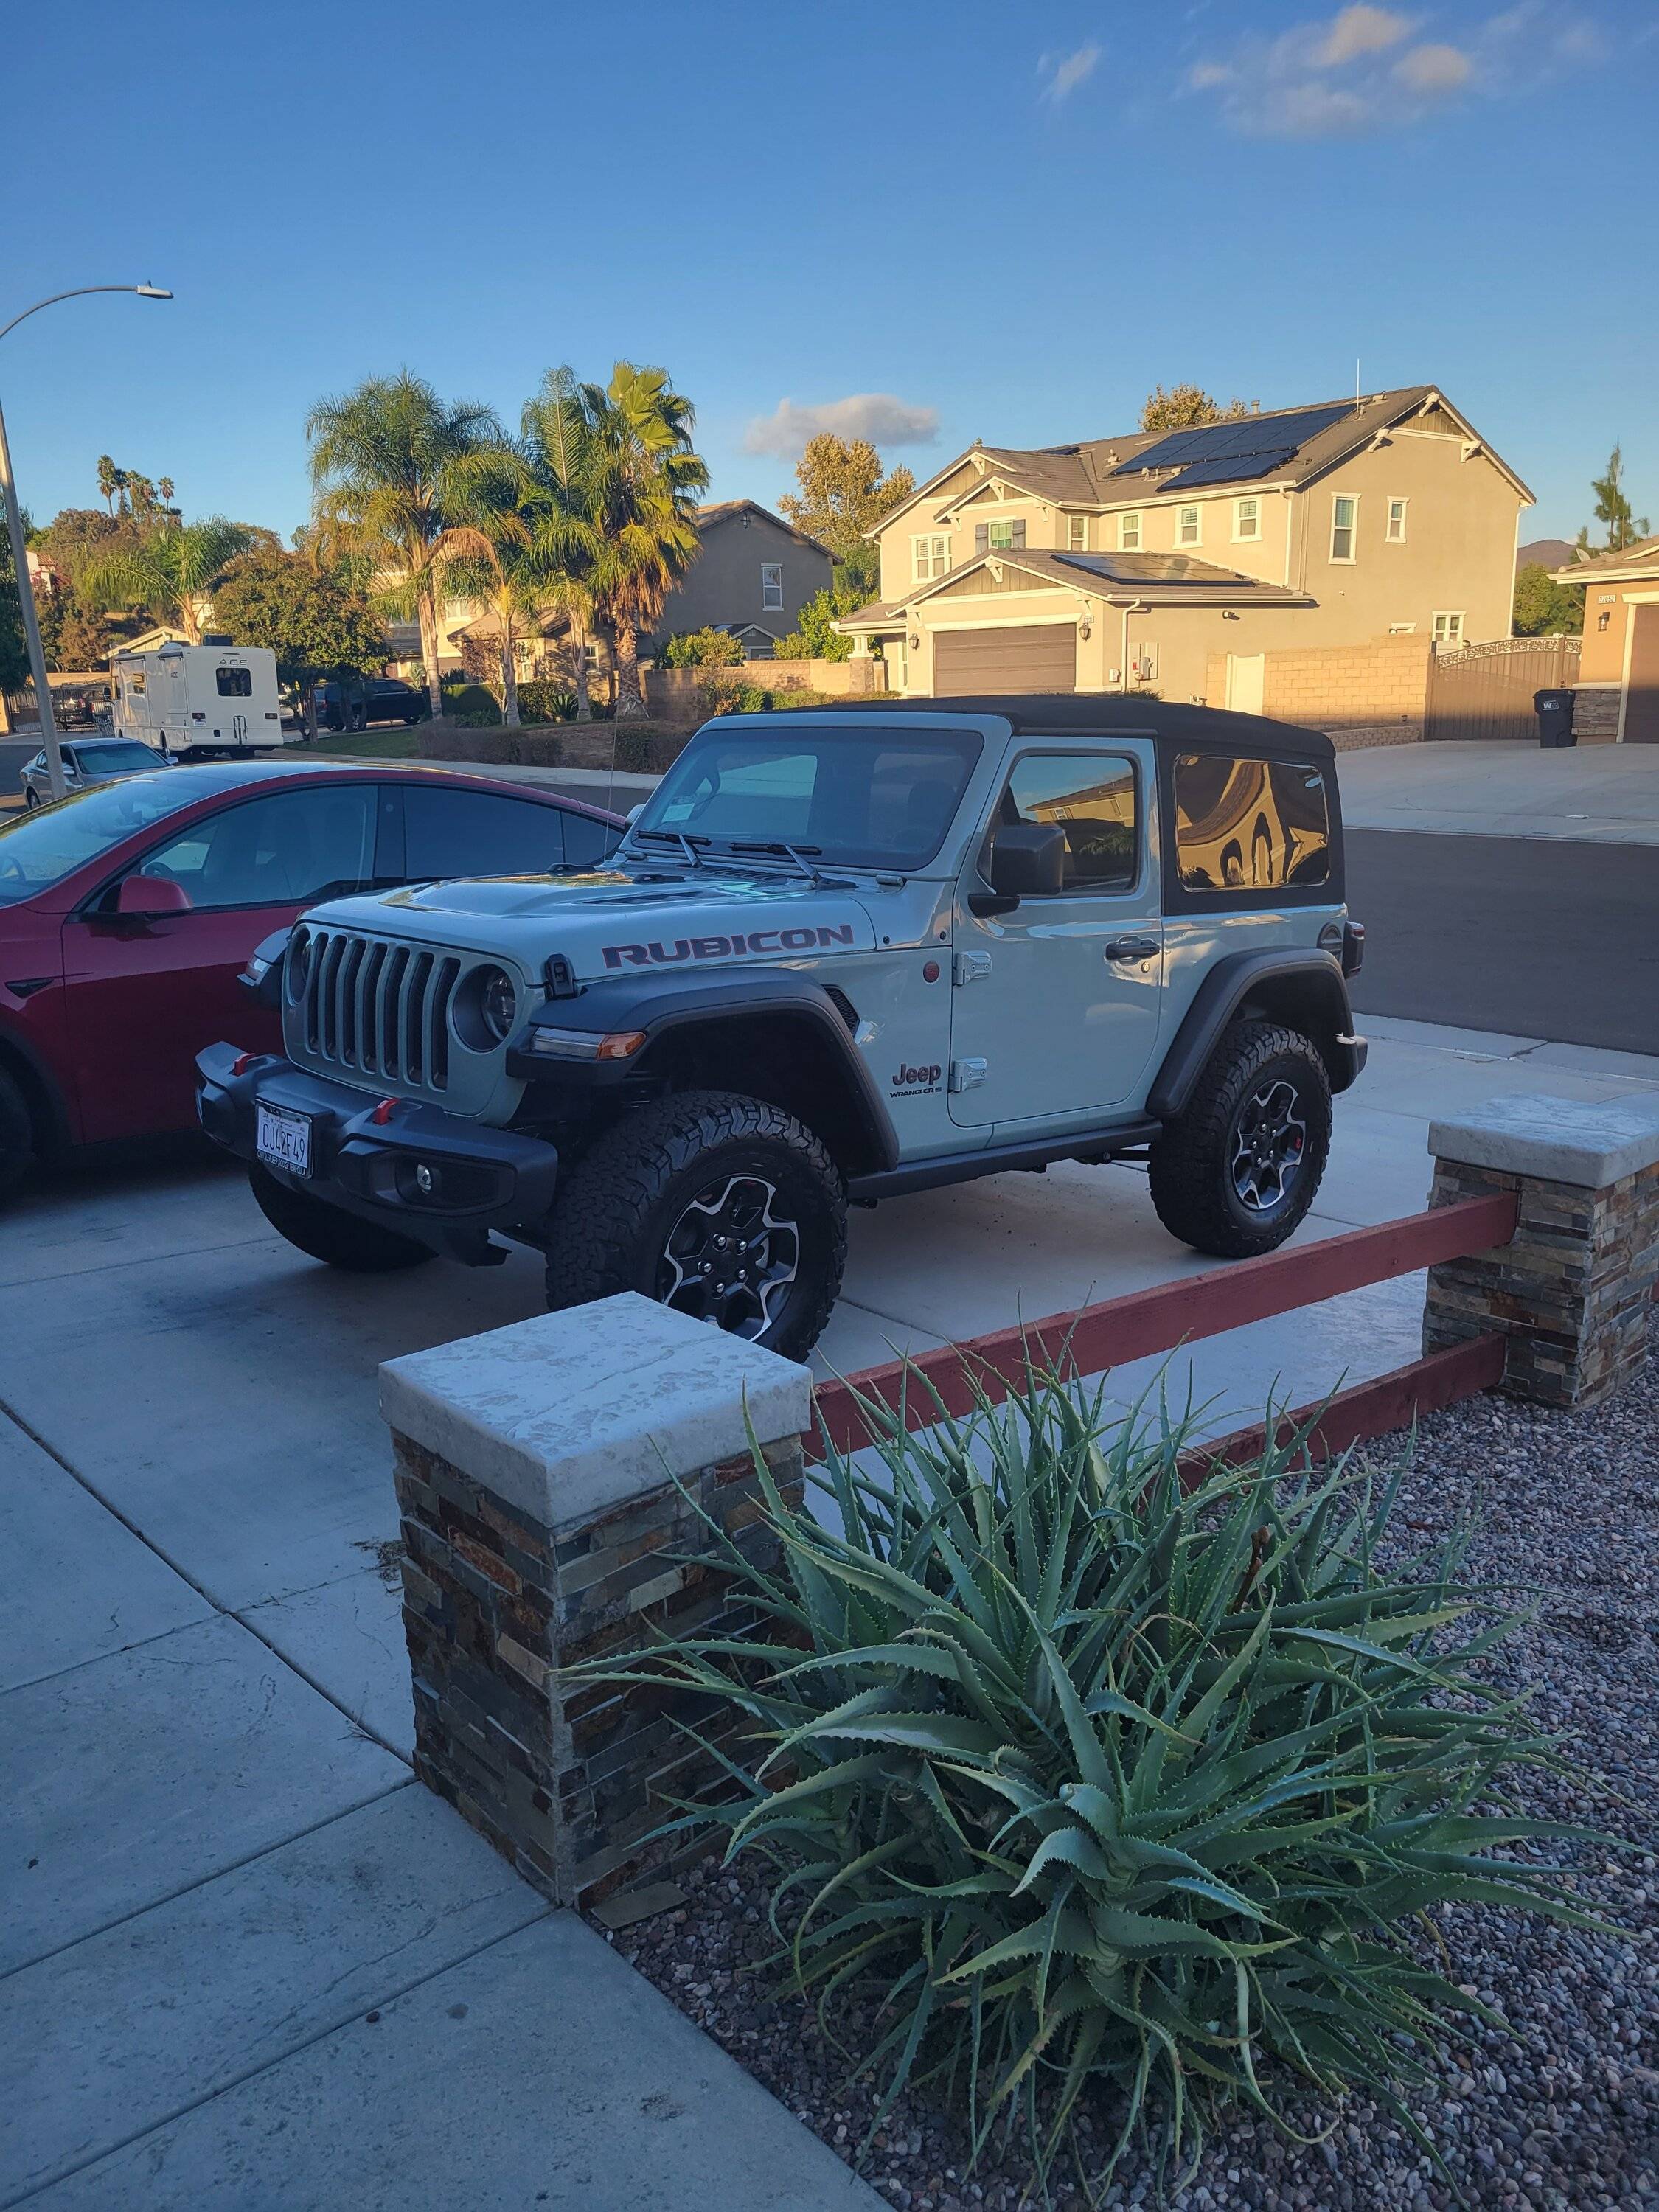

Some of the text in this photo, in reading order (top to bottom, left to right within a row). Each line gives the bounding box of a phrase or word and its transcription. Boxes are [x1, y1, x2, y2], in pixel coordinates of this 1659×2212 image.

[601, 924, 855, 969] RUBICON
[892, 1063, 942, 1086] Jeep
[889, 1088, 934, 1098] WRANGLER
